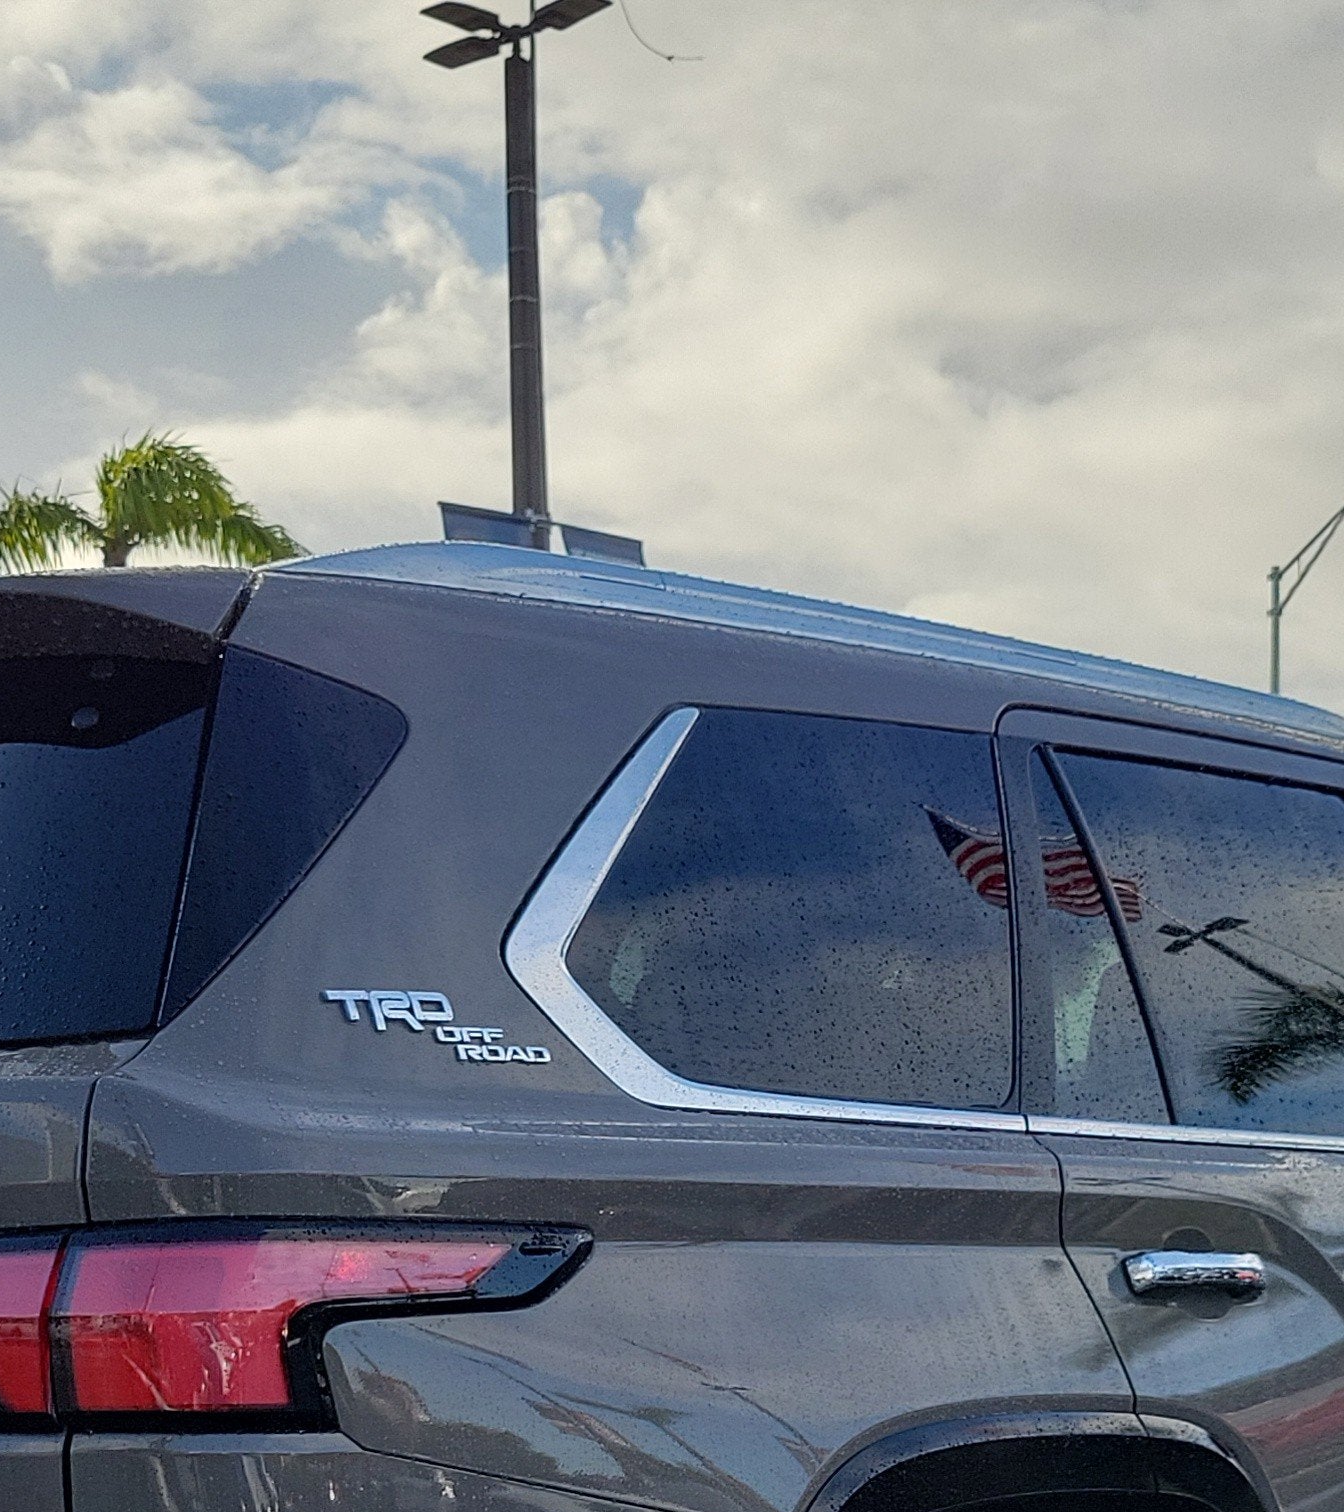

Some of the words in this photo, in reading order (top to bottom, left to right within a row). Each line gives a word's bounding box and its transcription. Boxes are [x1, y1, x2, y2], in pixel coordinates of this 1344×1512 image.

[324, 989, 454, 1031] TRD
[435, 1026, 504, 1043] OFF
[457, 1044, 552, 1063] ROAD
